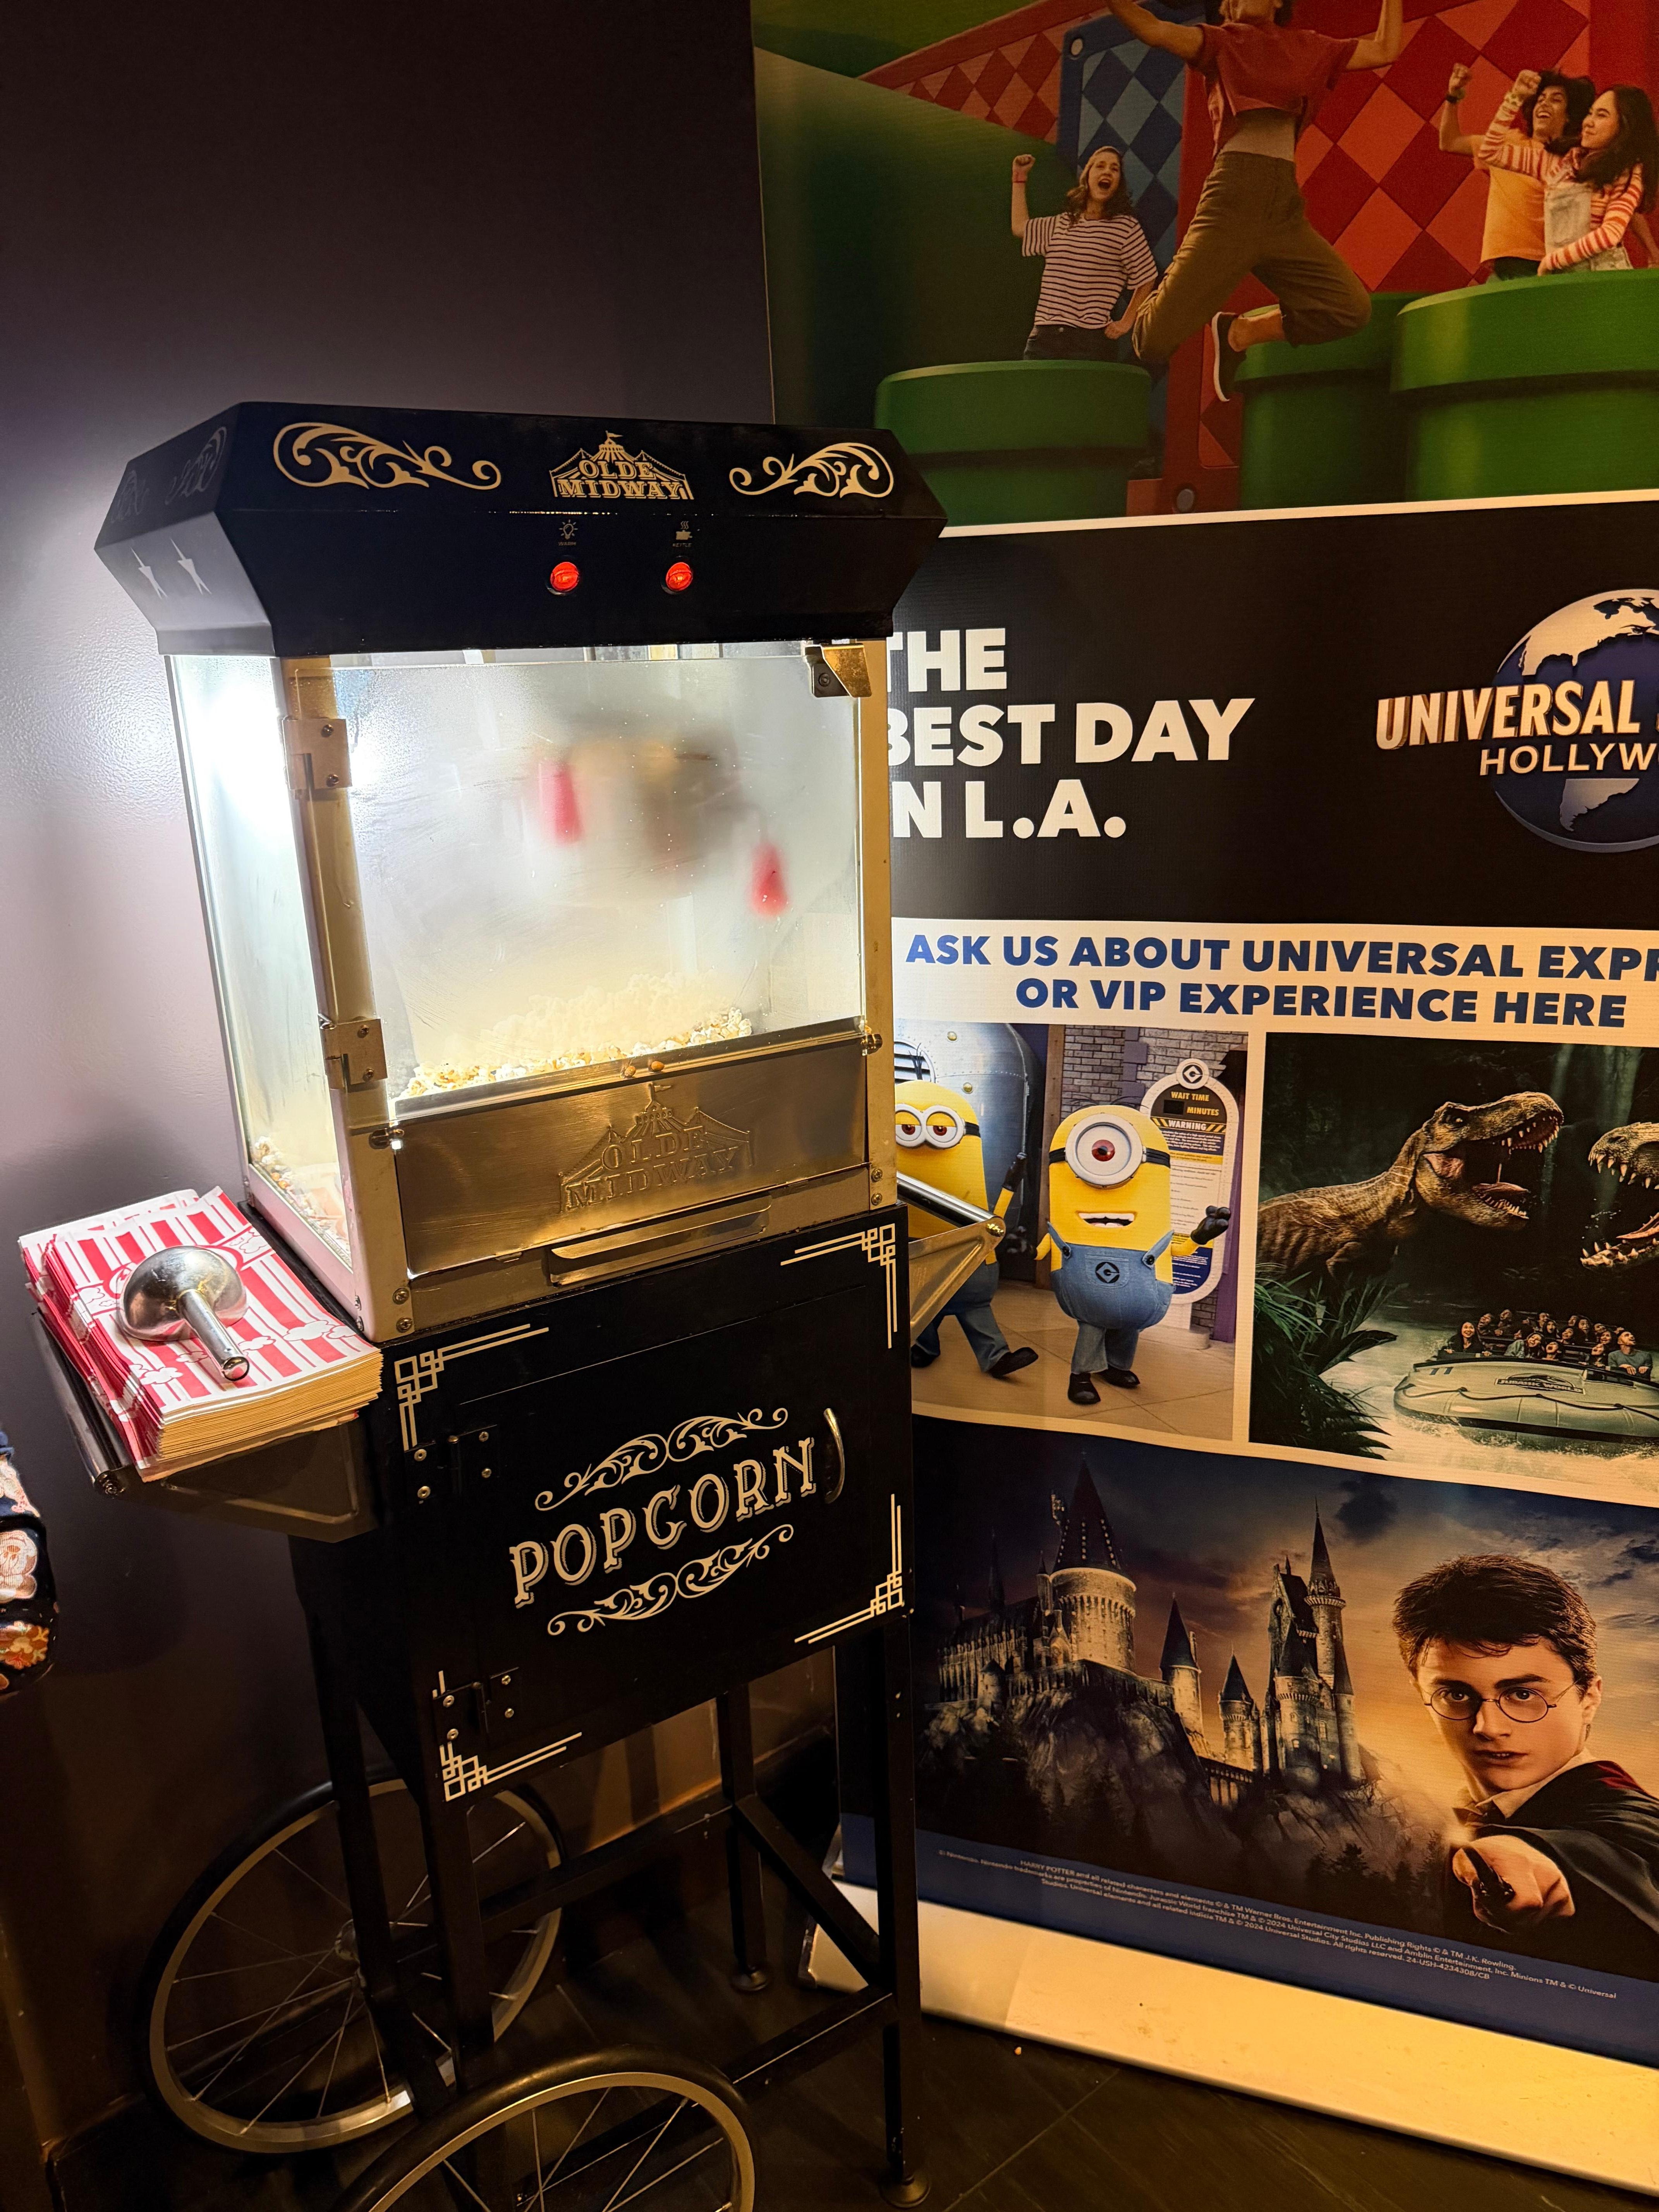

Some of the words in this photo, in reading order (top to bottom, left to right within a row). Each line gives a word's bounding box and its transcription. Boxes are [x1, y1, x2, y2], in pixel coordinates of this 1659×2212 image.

[558, 479, 682, 499] MIDWAY
[579, 460, 655, 480] OLDE
[1075, 698, 1255, 763] DAY
[1376, 680, 1640, 750] UNIVERSAL
[1480, 743, 1659, 776] HOLLYW
[892, 781, 942, 838] N
[965, 779, 1126, 838] L.A.
[906, 934, 991, 965] ASK
[1003, 936, 1058, 967] US
[1069, 936, 1230, 970] ABOUT
[1243, 940, 1523, 978] UNIVERSAL
[1016, 978, 1079, 1008] OR
[1091, 980, 1166, 1011] VIP
[1180, 982, 1478, 1023] EXPERIENCE
[1494, 991, 1626, 1028] HERE
[1168, 1120, 1207, 1130] WARNING
[1187, 1107, 1219, 1116] MINUTES
[601, 1126, 709, 1171] OLDE
[563, 1146, 739, 1210] MIDWAY
[1543, 1383, 1583, 1393] WORLD
[509, 1437, 816, 1608] POPCORN
[1202, 1905, 1235, 1917] franchise
[1267, 1919, 1286, 1928] 2024
[1288, 1924, 1322, 1936] Universal
[1324, 1932, 1339, 1941] City
[1341, 1936, 1369, 1947] Studios
[1404, 1949, 1432, 1960] Amblin
[1511, 1972, 1543, 1984] Minions
[1545, 1978, 1558, 1986] TM
[1578, 1986, 1616, 1999] Universal
[1244, 1921, 1264, 1930] 2024
[1265, 1925, 1299, 1938] Universal
[1345, 1944, 1367, 1953] rights
[1245, 1908, 1272, 1917] Warner
[1295, 1918, 1347, 1935] Entertainment
[1365, 1933, 1405, 1948] Publishing
[1407, 1942, 1431, 1952] Rights
